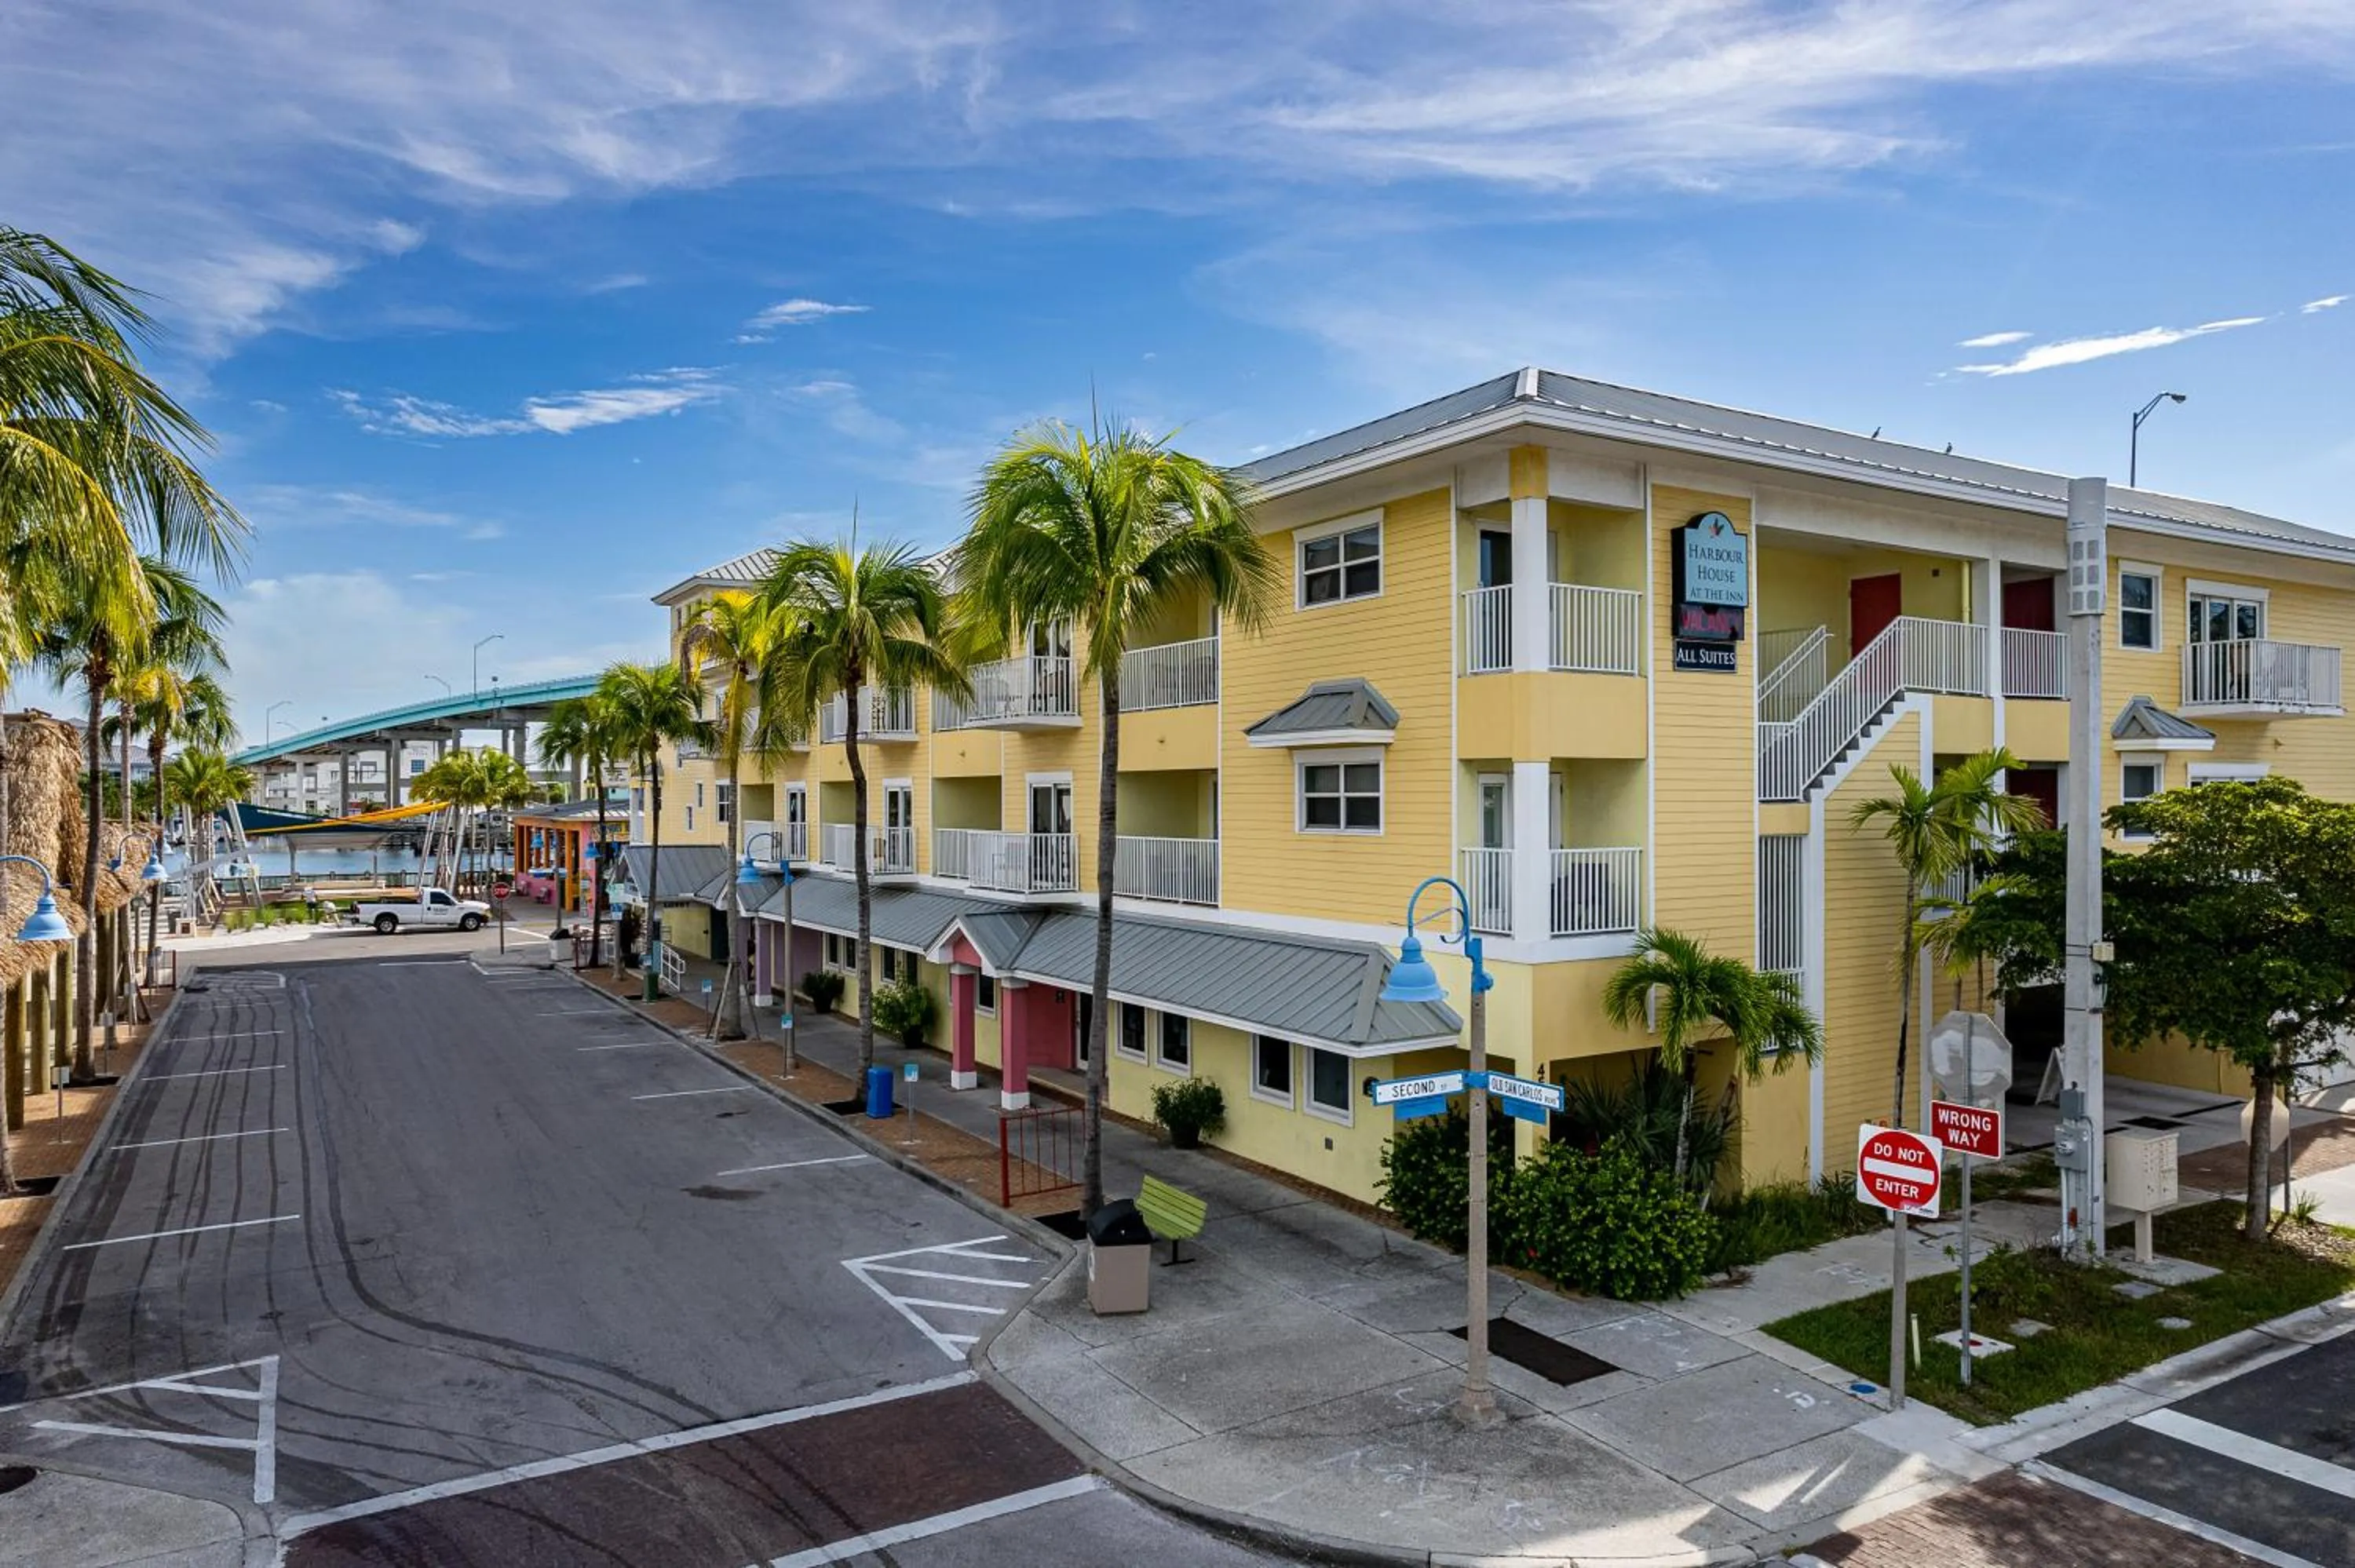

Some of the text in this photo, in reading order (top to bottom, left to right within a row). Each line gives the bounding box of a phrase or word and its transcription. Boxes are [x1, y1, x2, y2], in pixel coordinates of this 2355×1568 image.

[1689, 543, 1743, 564] HARBOUR
[1698, 564, 1735, 583] HOUSE
[1690, 586, 1743, 603] AT THE INN
[1677, 647, 1736, 665] ALL SUITES
[1392, 1081, 1436, 1098] SECOND
[1492, 1078, 1504, 1092] OLD
[1504, 1081, 1517, 1096] SAN
[1518, 1084, 1544, 1102] CARLOS
[1938, 1108, 1992, 1132] WRONG
[1948, 1128, 1981, 1148] WAY
[1874, 1142, 1926, 1164] DO NOT
[1875, 1178, 1920, 1198] ENTER
